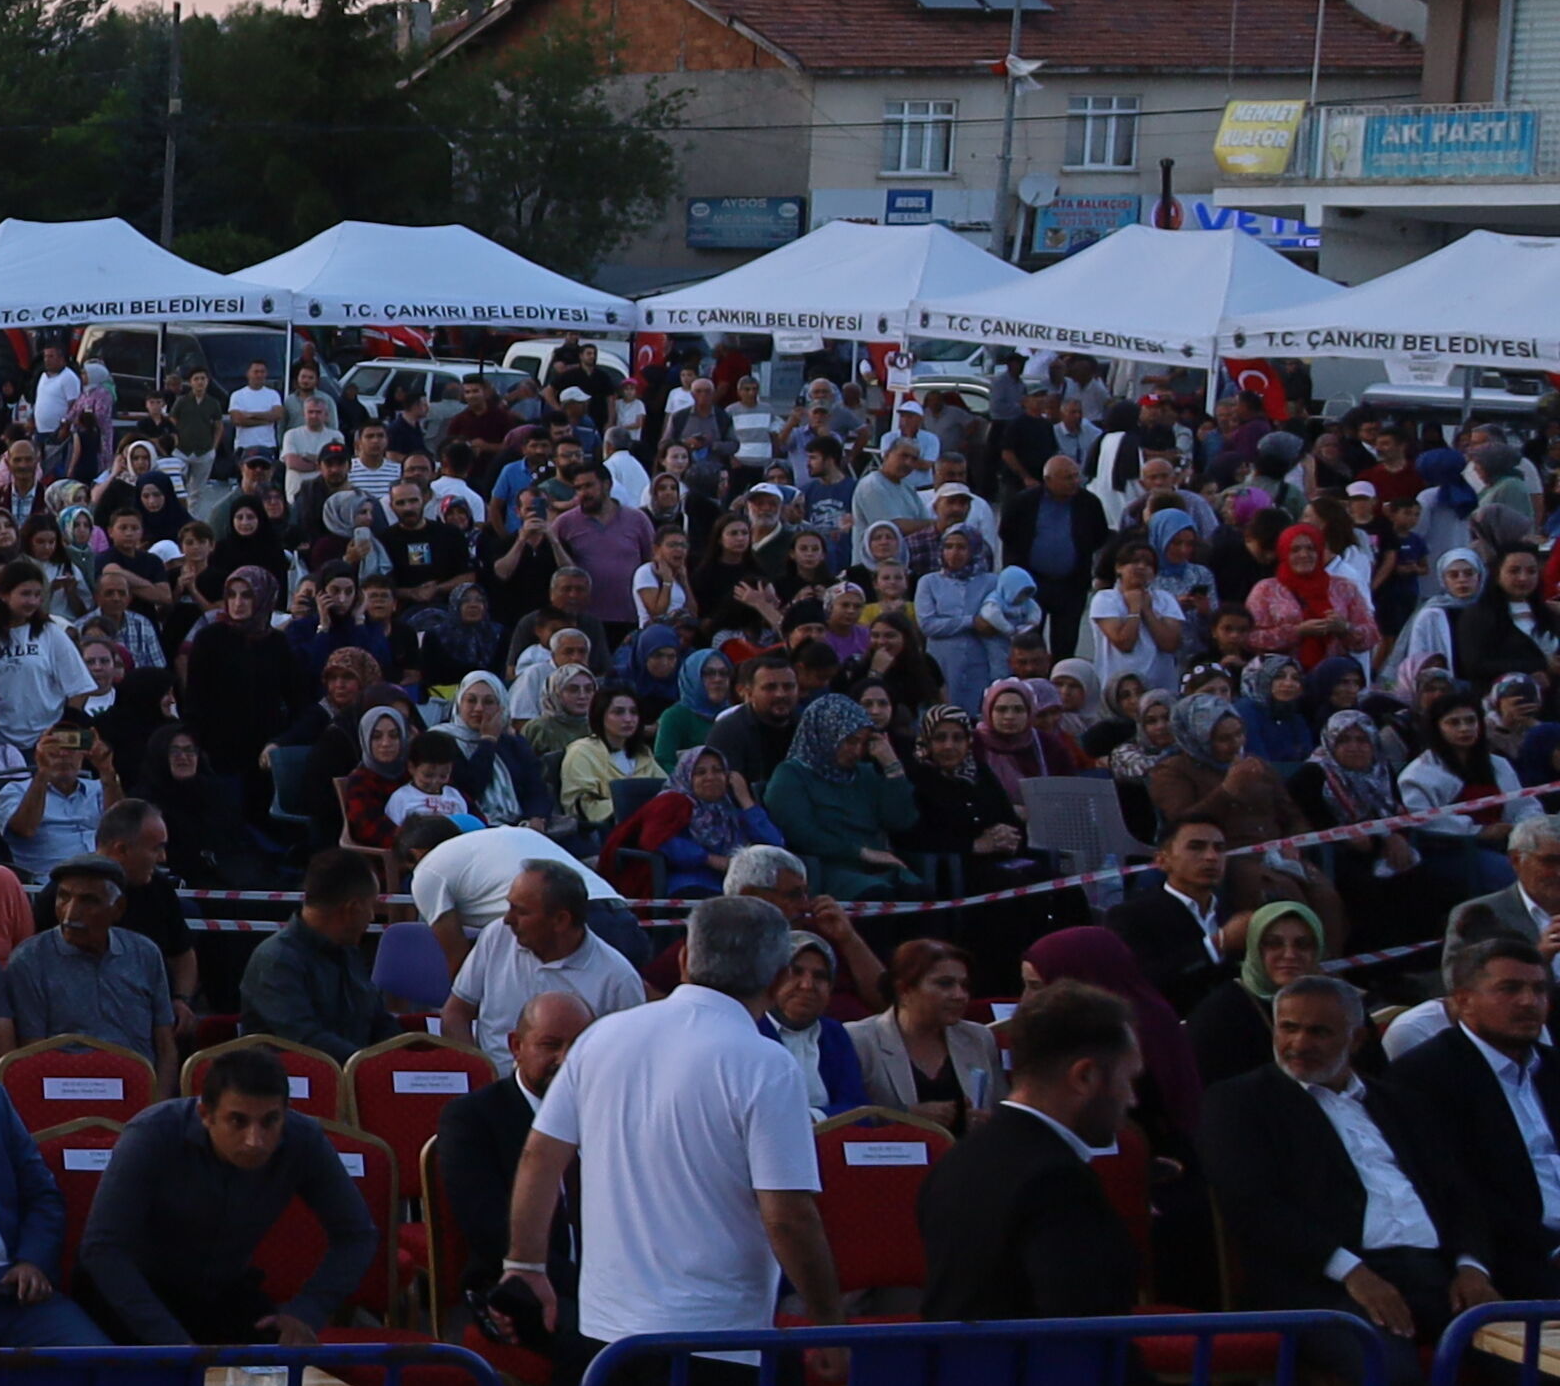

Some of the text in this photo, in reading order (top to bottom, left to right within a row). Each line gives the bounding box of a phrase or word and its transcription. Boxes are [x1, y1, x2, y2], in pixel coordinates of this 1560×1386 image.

[1380, 123, 1424, 146] AK
[1, 295, 245, 325] T.C. ÇANKIRI BELEDİYESİ
[342, 303, 589, 322] T.C. ÇANKIRI BELEDİYESİ
[667, 308, 863, 331] T.C. ÇANKIRI BELEDİYESİ
[946, 315, 974, 332] T.C.
[980, 318, 1053, 341] ÇANKIRI
[1265, 330, 1539, 359] T.C. ÇANKIRI BELEDİYESİ
